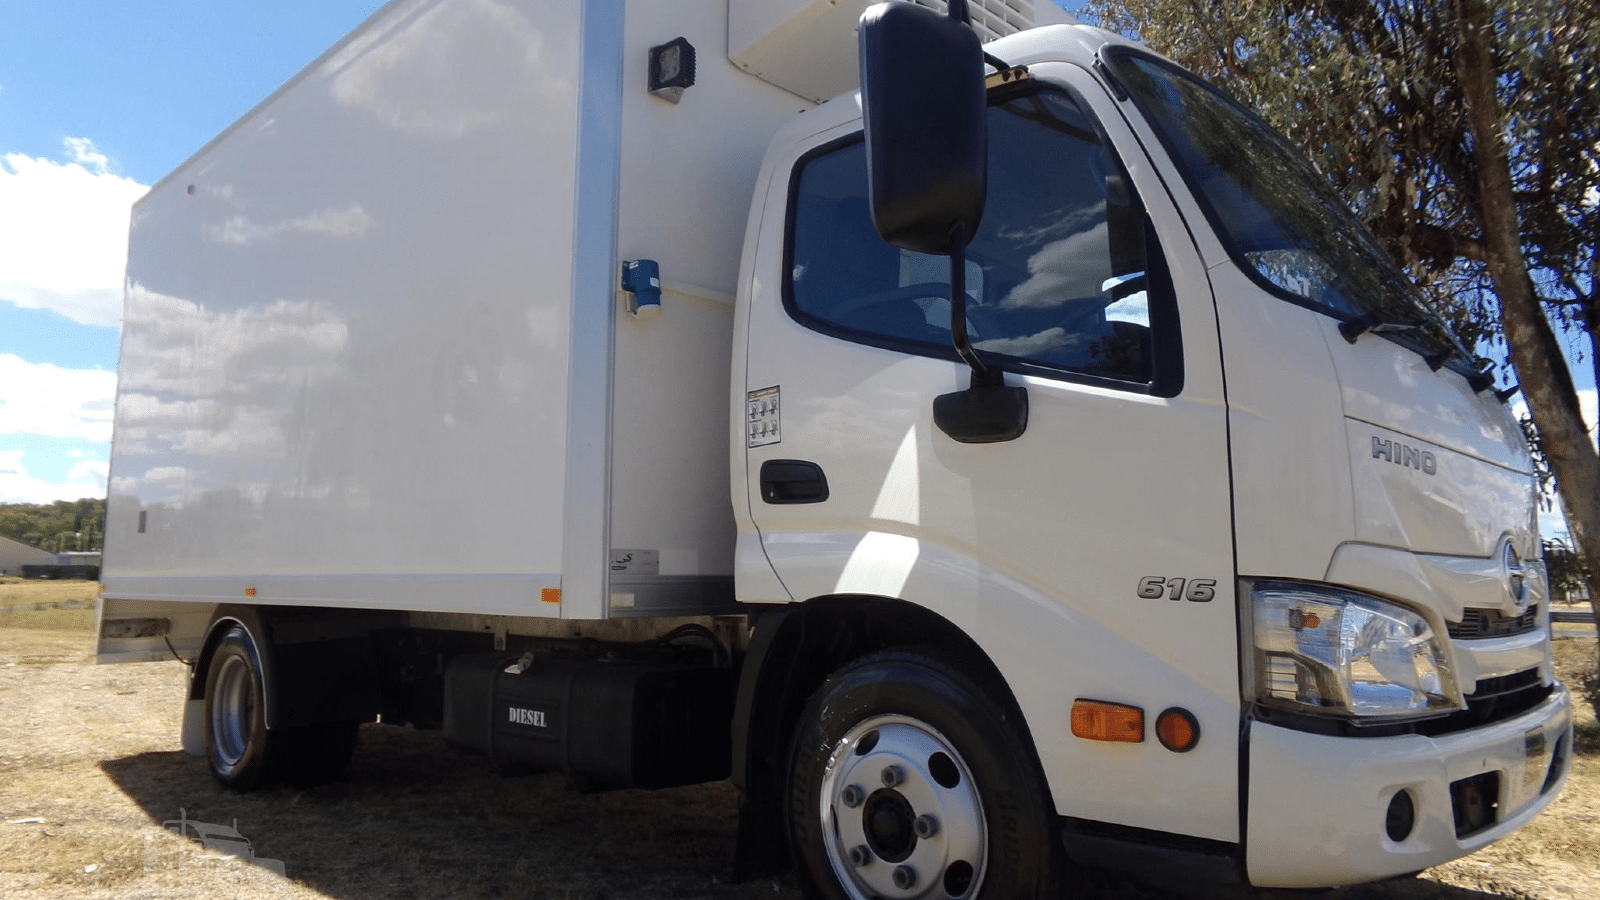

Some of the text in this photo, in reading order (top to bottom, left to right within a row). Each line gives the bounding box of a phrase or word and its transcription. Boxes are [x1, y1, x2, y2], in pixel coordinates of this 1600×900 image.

[1372, 436, 1437, 476] HINO
[1137, 576, 1217, 602] 616
[509, 707, 547, 728] DIESEL
